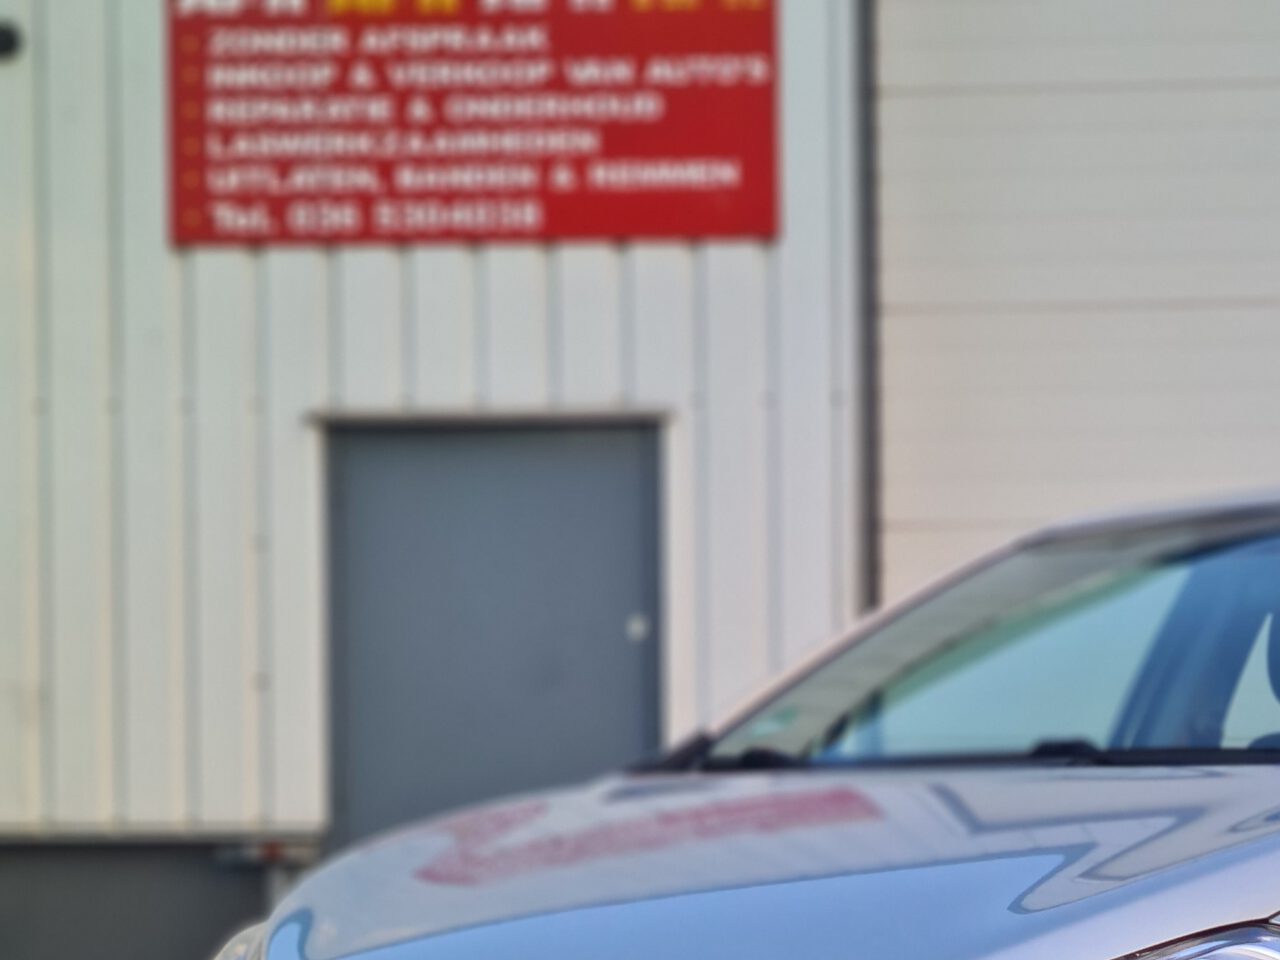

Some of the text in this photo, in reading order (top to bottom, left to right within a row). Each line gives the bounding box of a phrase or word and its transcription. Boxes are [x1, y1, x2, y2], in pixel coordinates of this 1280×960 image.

[210, 26, 549, 55] ZONDER AFSPRAAK
[207, 55, 771, 87] INKOOP & VERKOOP VAN AUTO'S
[207, 93, 665, 123] REPARATIE & ONDERHOUD
[393, 163, 541, 189] BANDEN
[550, 163, 576, 189] &
[587, 160, 742, 186] REMMEN
